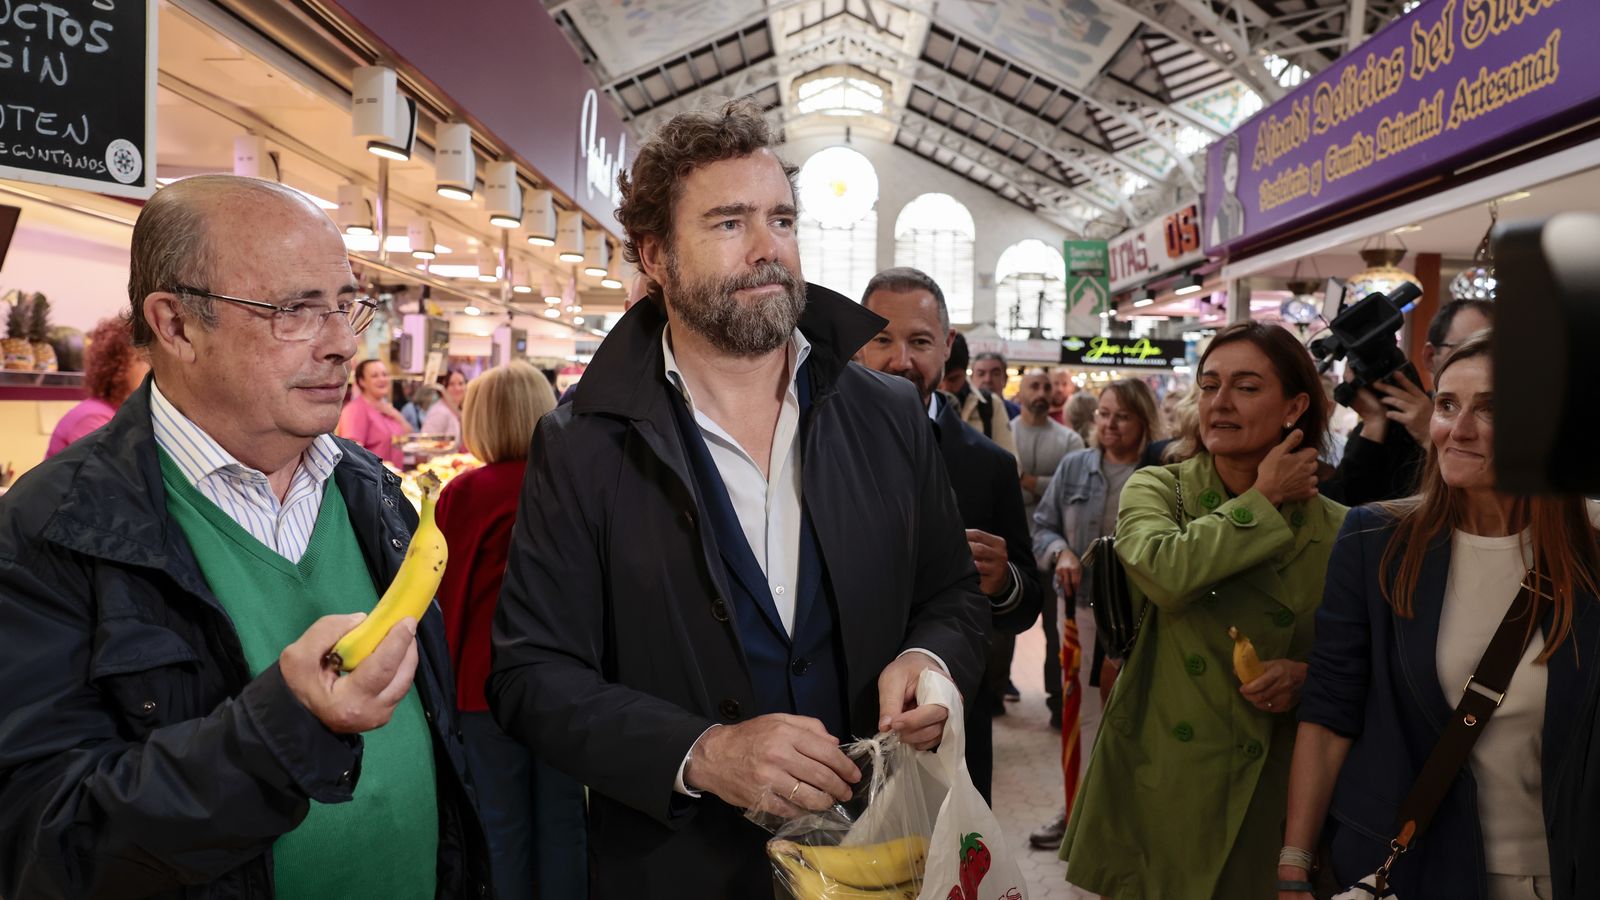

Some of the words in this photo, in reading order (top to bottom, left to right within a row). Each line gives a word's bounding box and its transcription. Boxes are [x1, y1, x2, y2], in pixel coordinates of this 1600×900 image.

[0, 104, 89, 145] TEN
[1313, 45, 1405, 135] Delicias
[1410, 1, 1456, 81] del
[1325, 131, 1374, 183] Comida
[1375, 88, 1445, 161] Oriental
[1446, 28, 1562, 131] Artesanal
